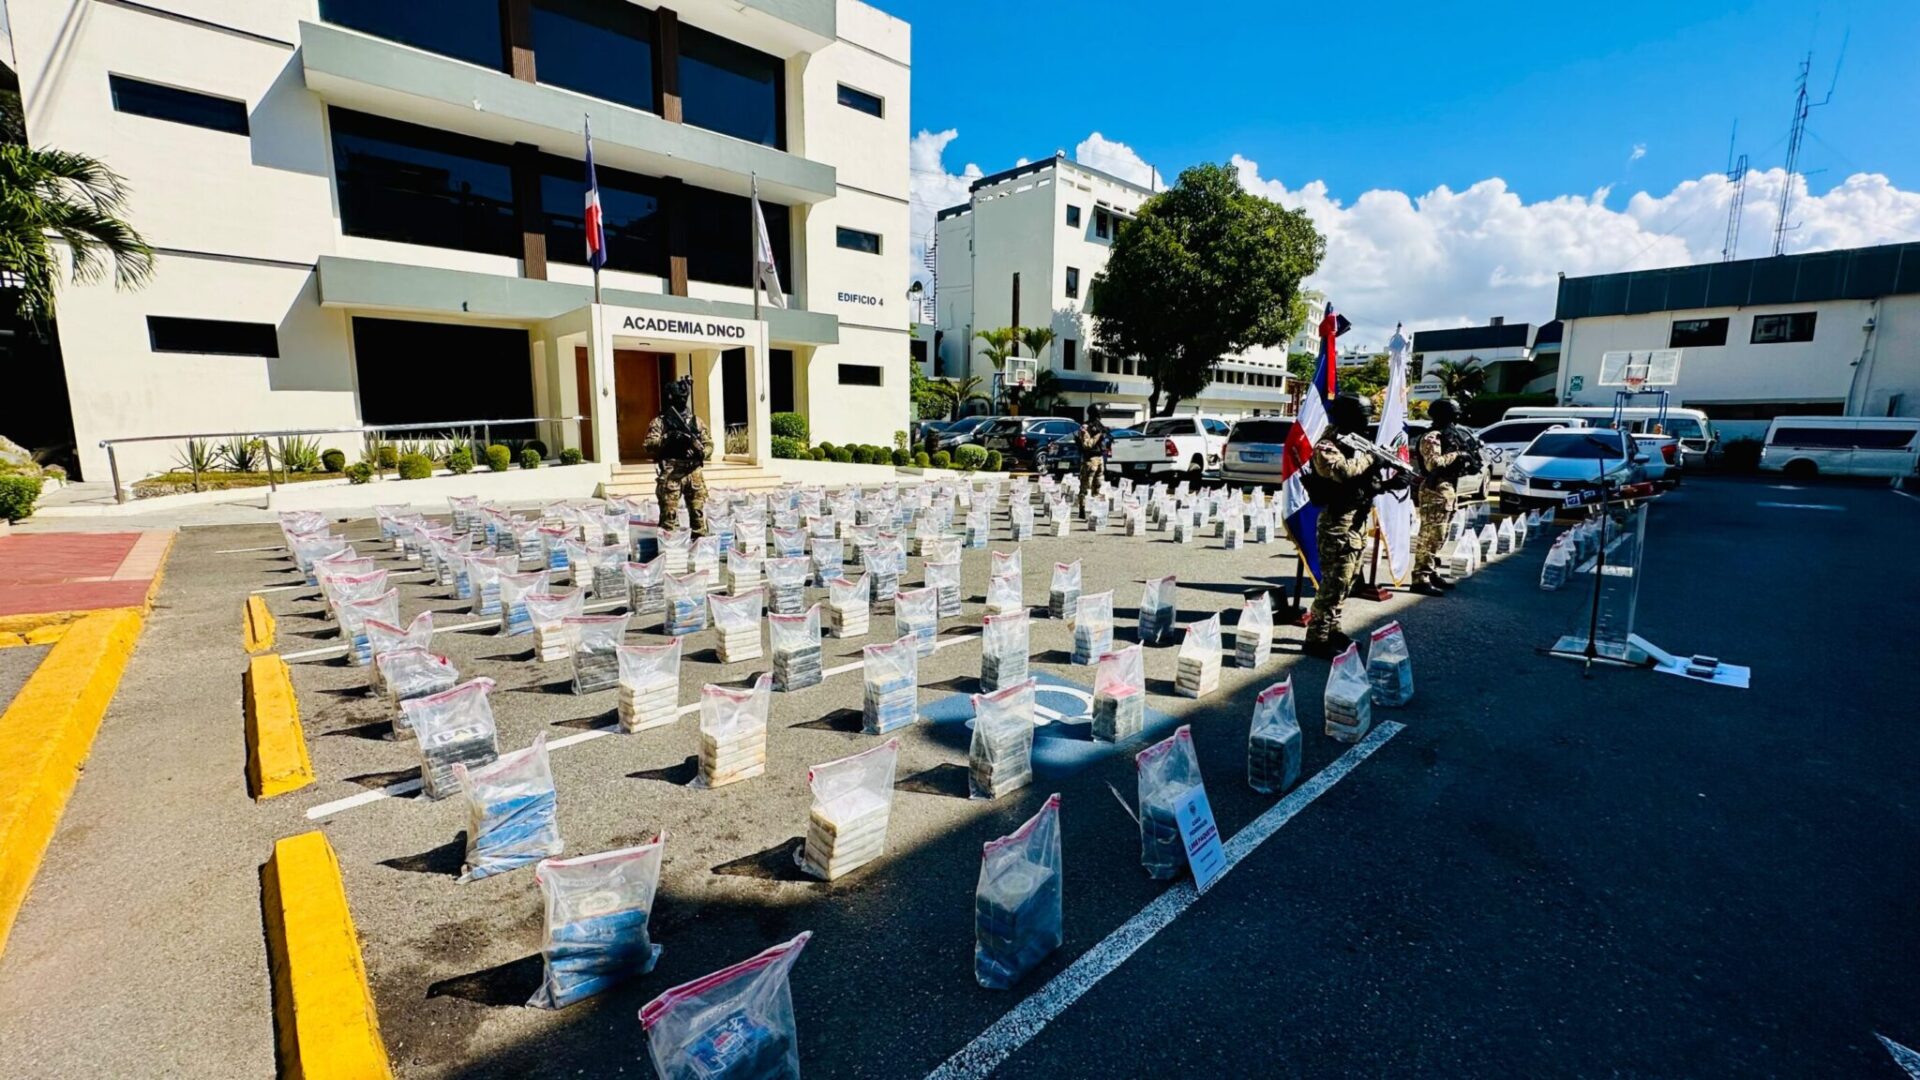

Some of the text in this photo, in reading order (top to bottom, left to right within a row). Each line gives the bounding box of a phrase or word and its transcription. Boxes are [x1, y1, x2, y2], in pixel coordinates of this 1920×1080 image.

[838, 292, 884, 306] EDIFICIO 4
[623, 315, 745, 338] ACADEMIA DNCD
